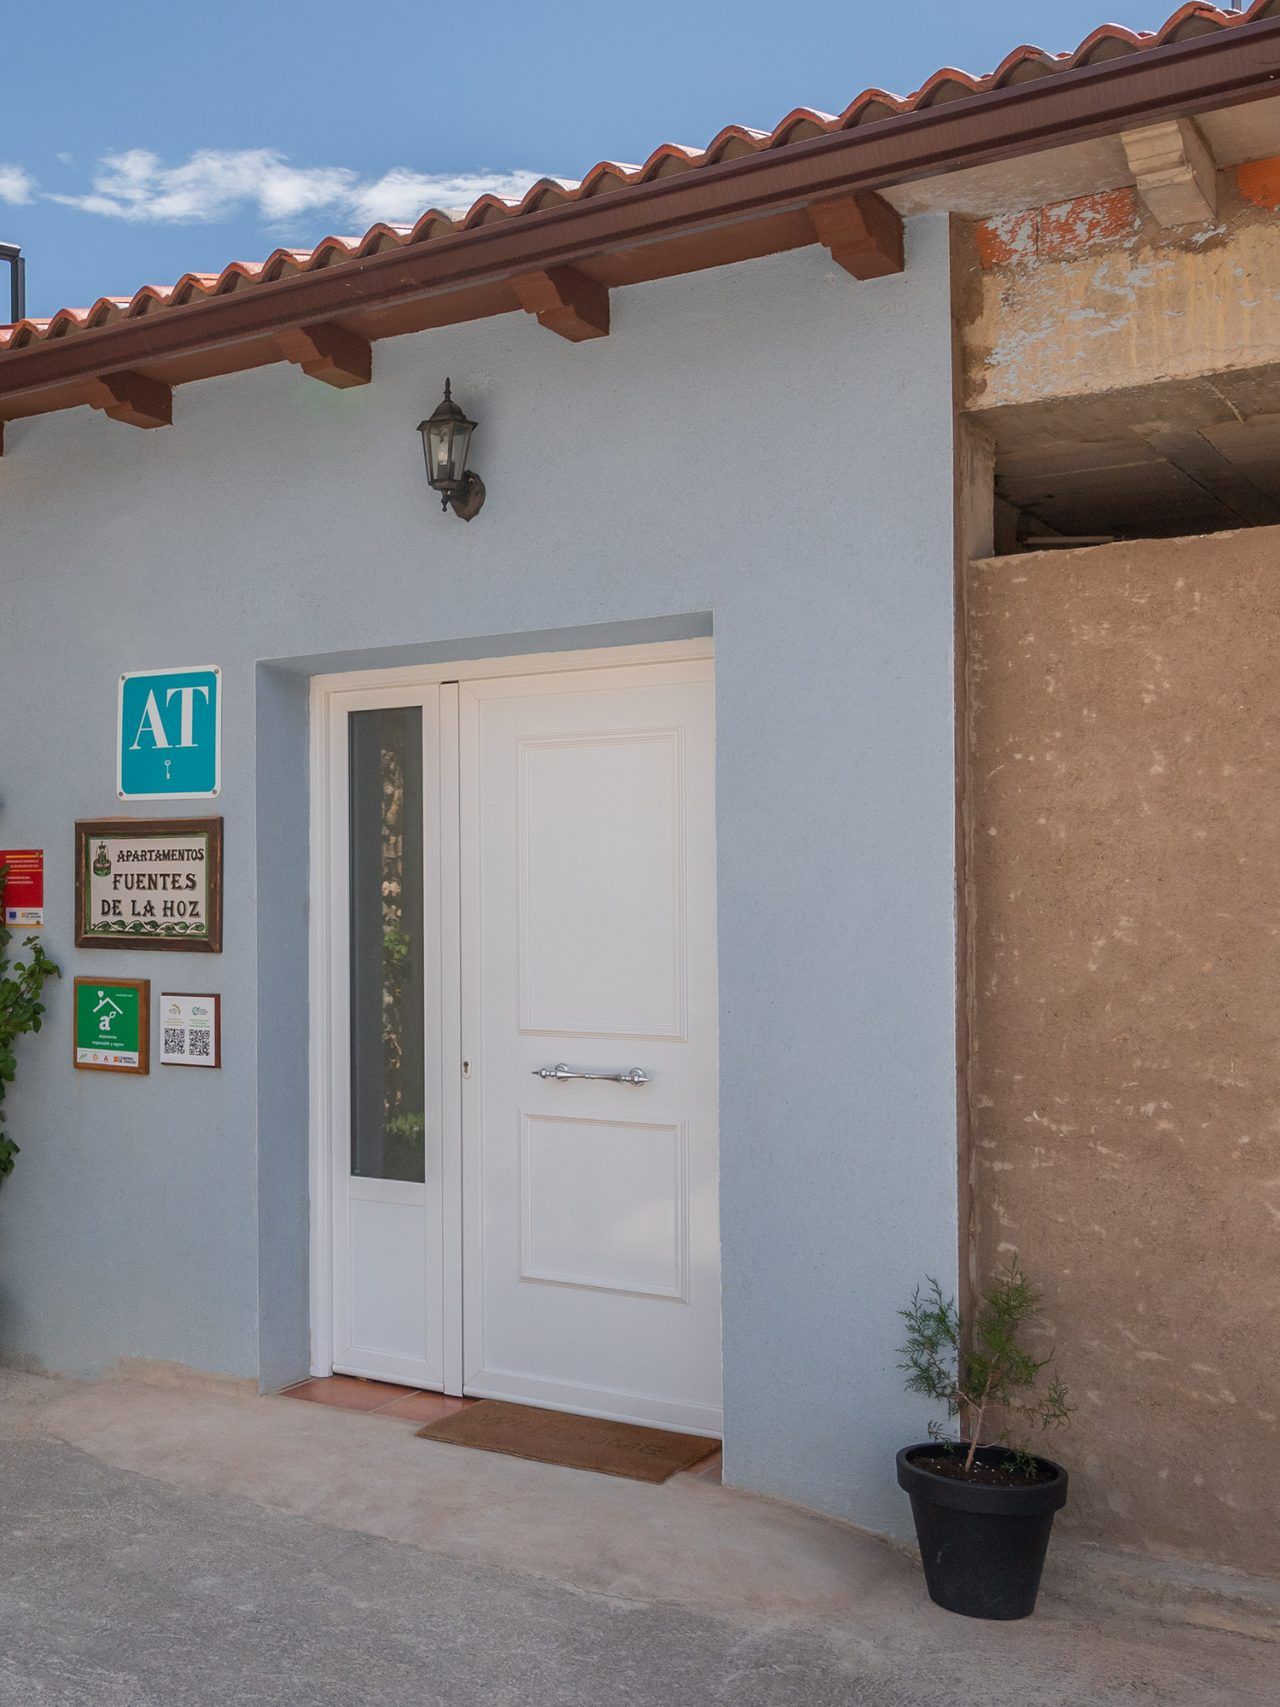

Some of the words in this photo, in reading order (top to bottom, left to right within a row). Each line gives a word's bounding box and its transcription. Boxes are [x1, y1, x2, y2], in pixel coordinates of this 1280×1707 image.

[128, 686, 209, 750] AT
[116, 848, 205, 863] APARTAMENTOS
[112, 873, 198, 891] FUENTES
[100, 899, 122, 916] DE
[131, 899, 156, 917] LA
[162, 900, 201, 918] HOZ
